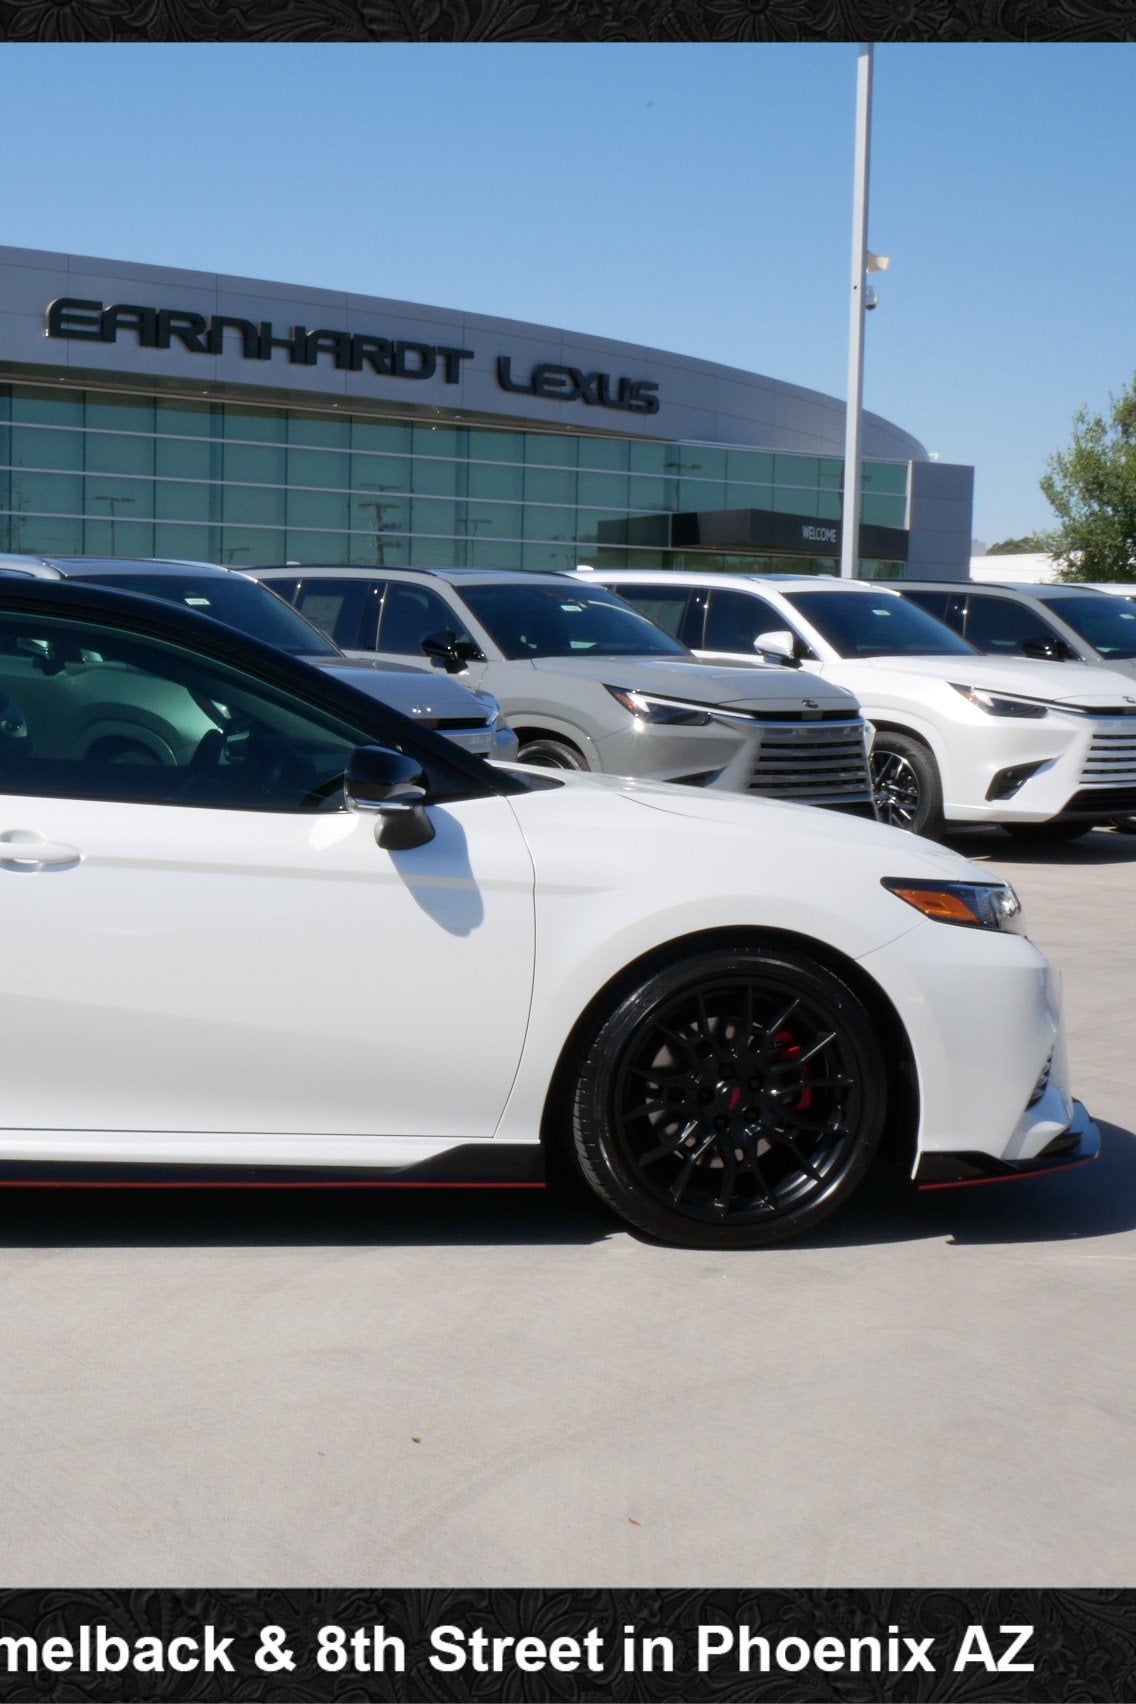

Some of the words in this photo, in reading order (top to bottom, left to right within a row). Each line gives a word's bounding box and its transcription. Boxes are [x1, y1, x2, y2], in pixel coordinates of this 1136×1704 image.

[45, 298, 474, 384] EARNHARDT
[497, 355, 660, 414] LEXUS
[802, 525, 837, 543] WELCOME
